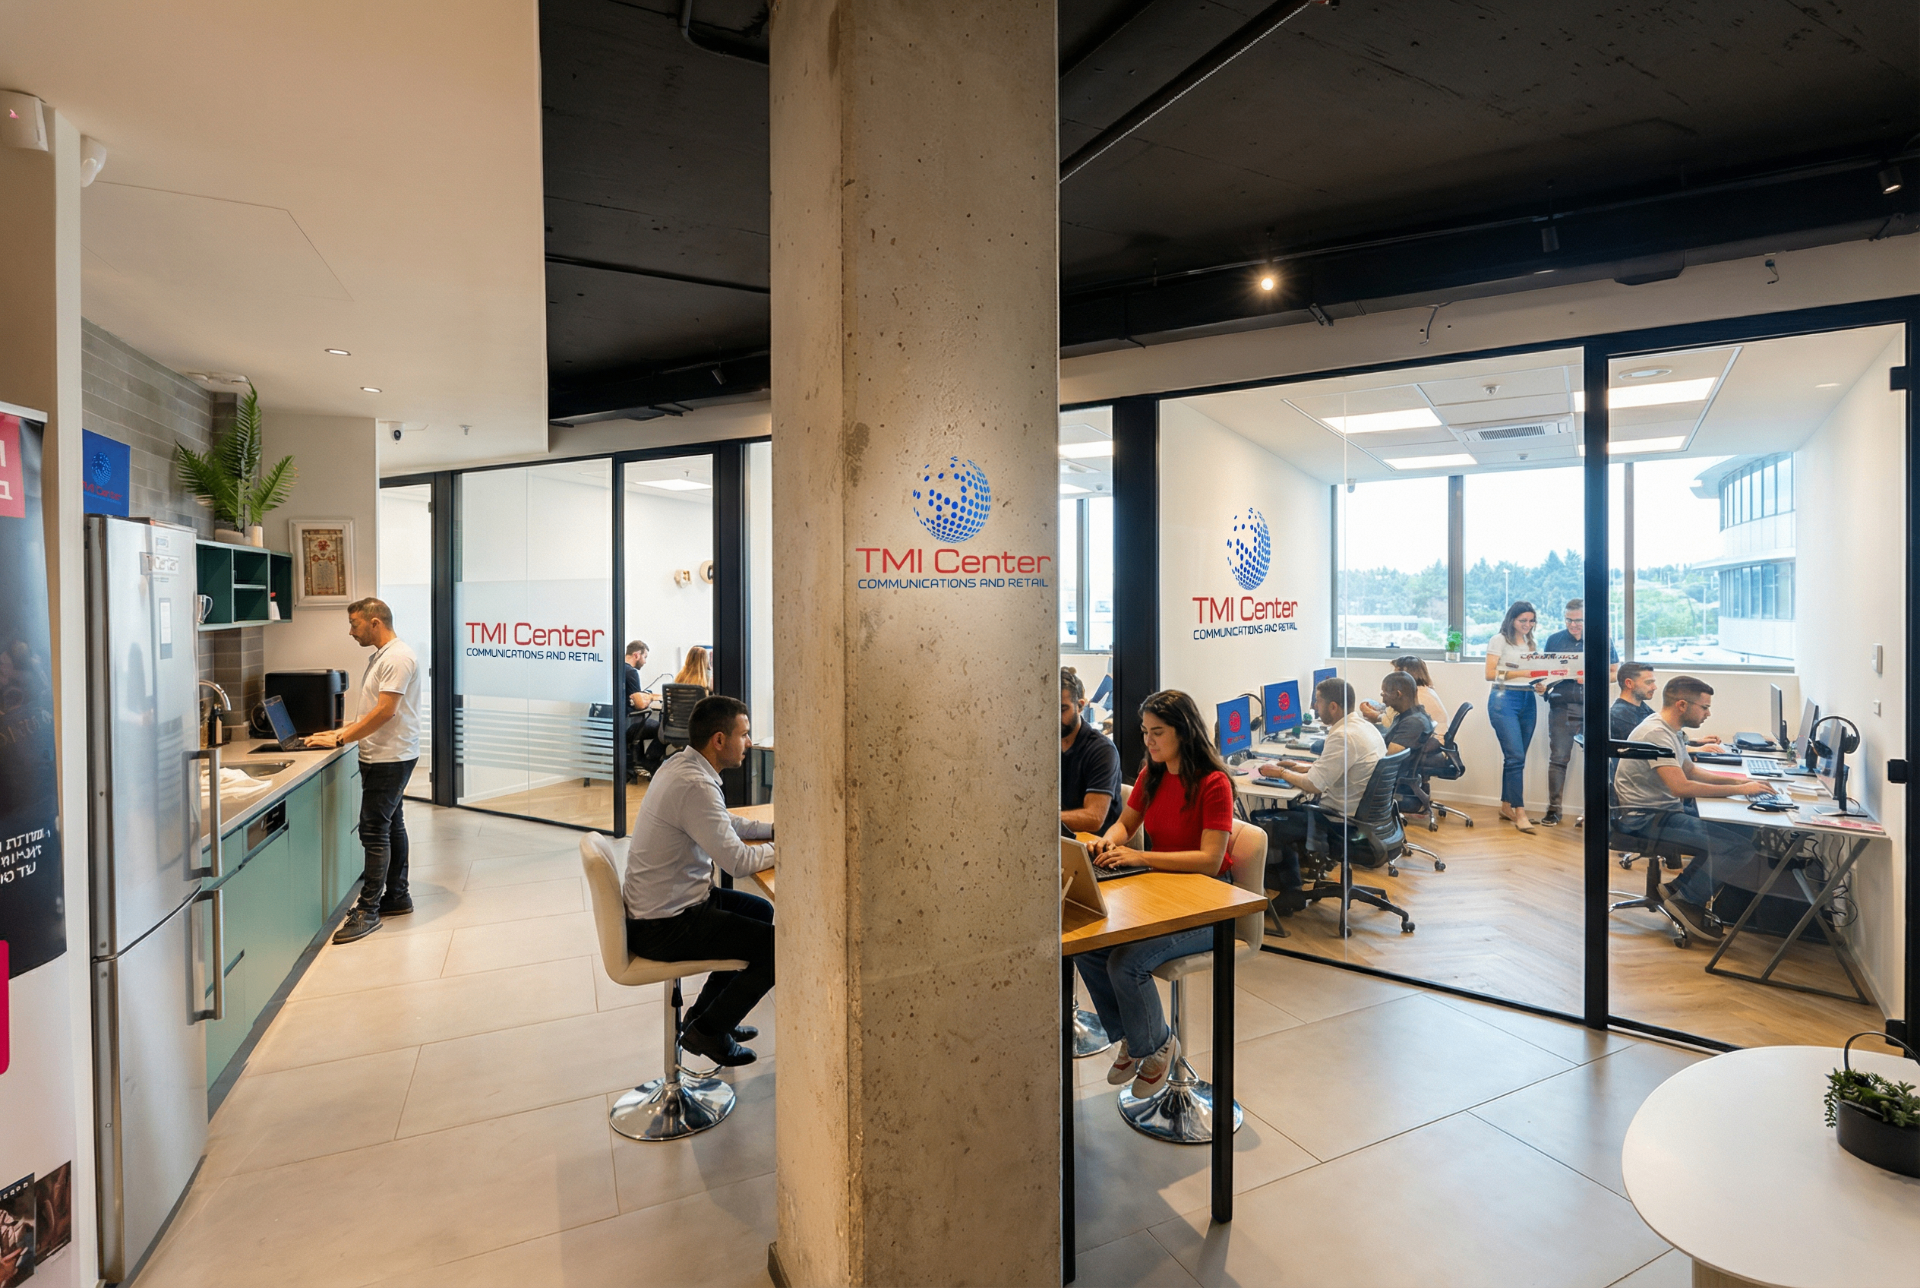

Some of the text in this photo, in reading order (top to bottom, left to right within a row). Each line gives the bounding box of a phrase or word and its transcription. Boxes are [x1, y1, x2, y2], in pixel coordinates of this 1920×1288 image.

[856, 548, 1051, 574] TMI Center
[857, 578, 1049, 589] COMMUNICATIONS AND RETAIL
[1192, 596, 1298, 624] TMI Center
[465, 622, 605, 648] TMI Center
[466, 648, 604, 662] COMMUNICATIONS AND RETAIL
